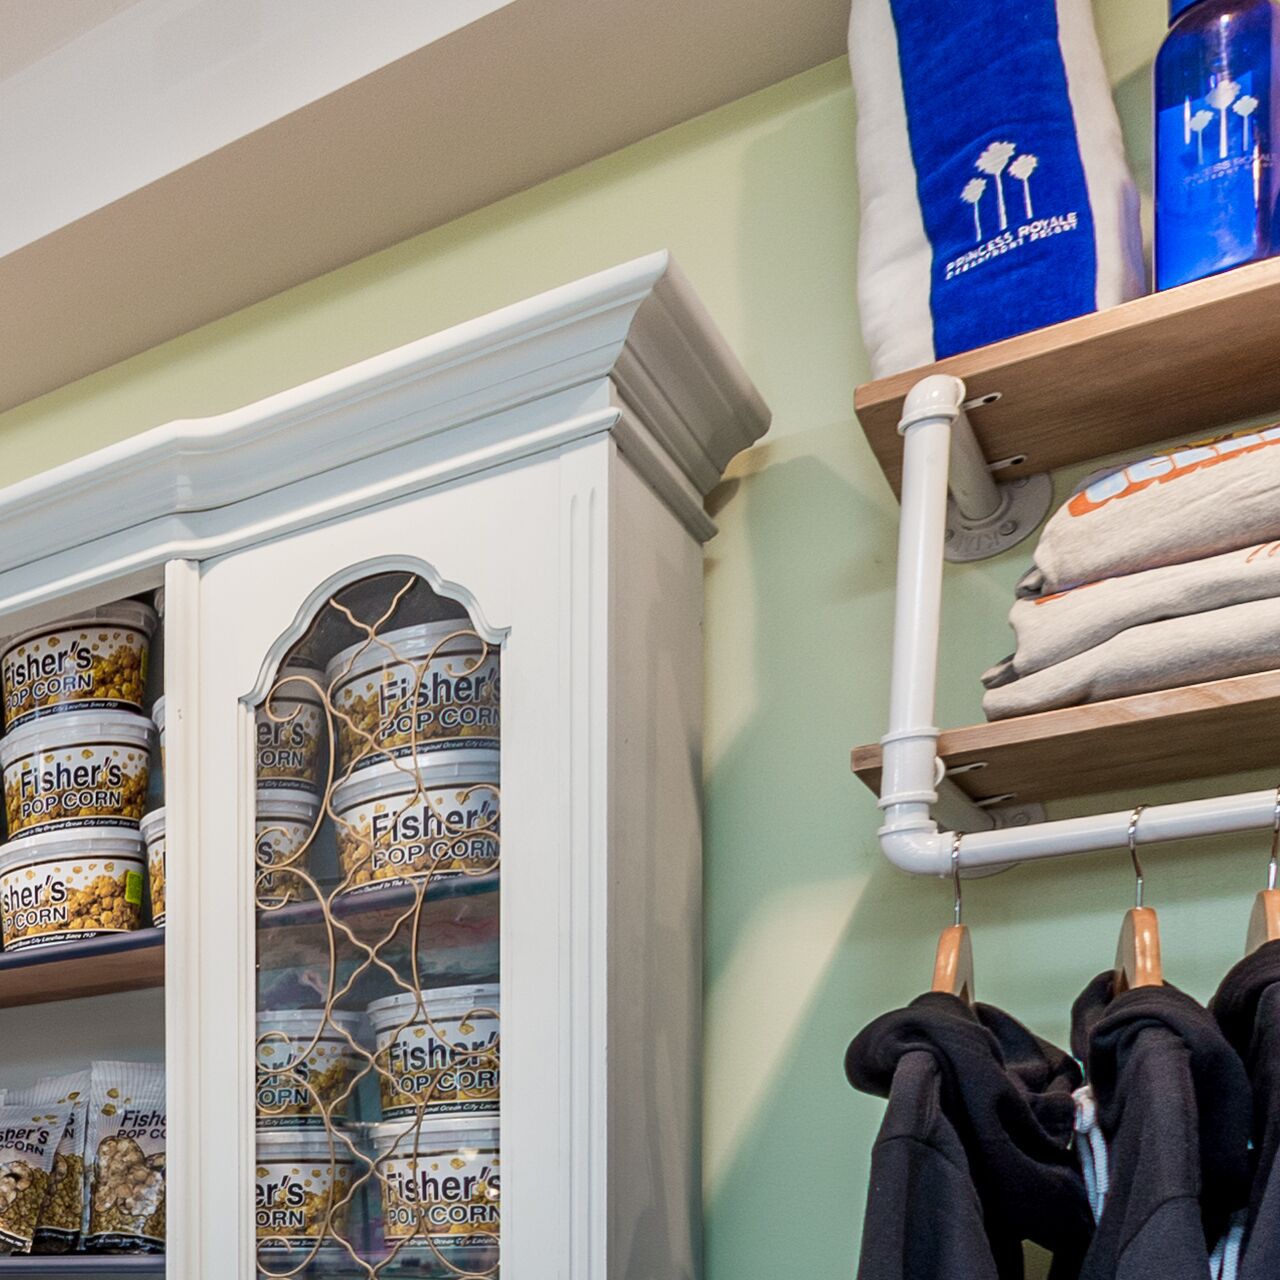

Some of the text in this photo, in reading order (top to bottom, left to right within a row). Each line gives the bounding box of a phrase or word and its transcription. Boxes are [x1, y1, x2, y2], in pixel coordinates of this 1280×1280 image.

[1017, 211, 1078, 237] ROYALE
[4, 641, 92, 689] Fisher's
[33, 673, 91, 698] CORN
[379, 712, 432, 740] POP
[258, 751, 303, 767] ORN
[20, 756, 122, 799] Fisher's
[22, 791, 121, 818] POP CORN
[372, 844, 424, 870] POP
[3, 874, 66, 914] sher's
[16, 906, 67, 929] CORN
[258, 1088, 309, 1106] ORN
[5, 1140, 44, 1157] CORN
[256, 1209, 304, 1228] ORN
